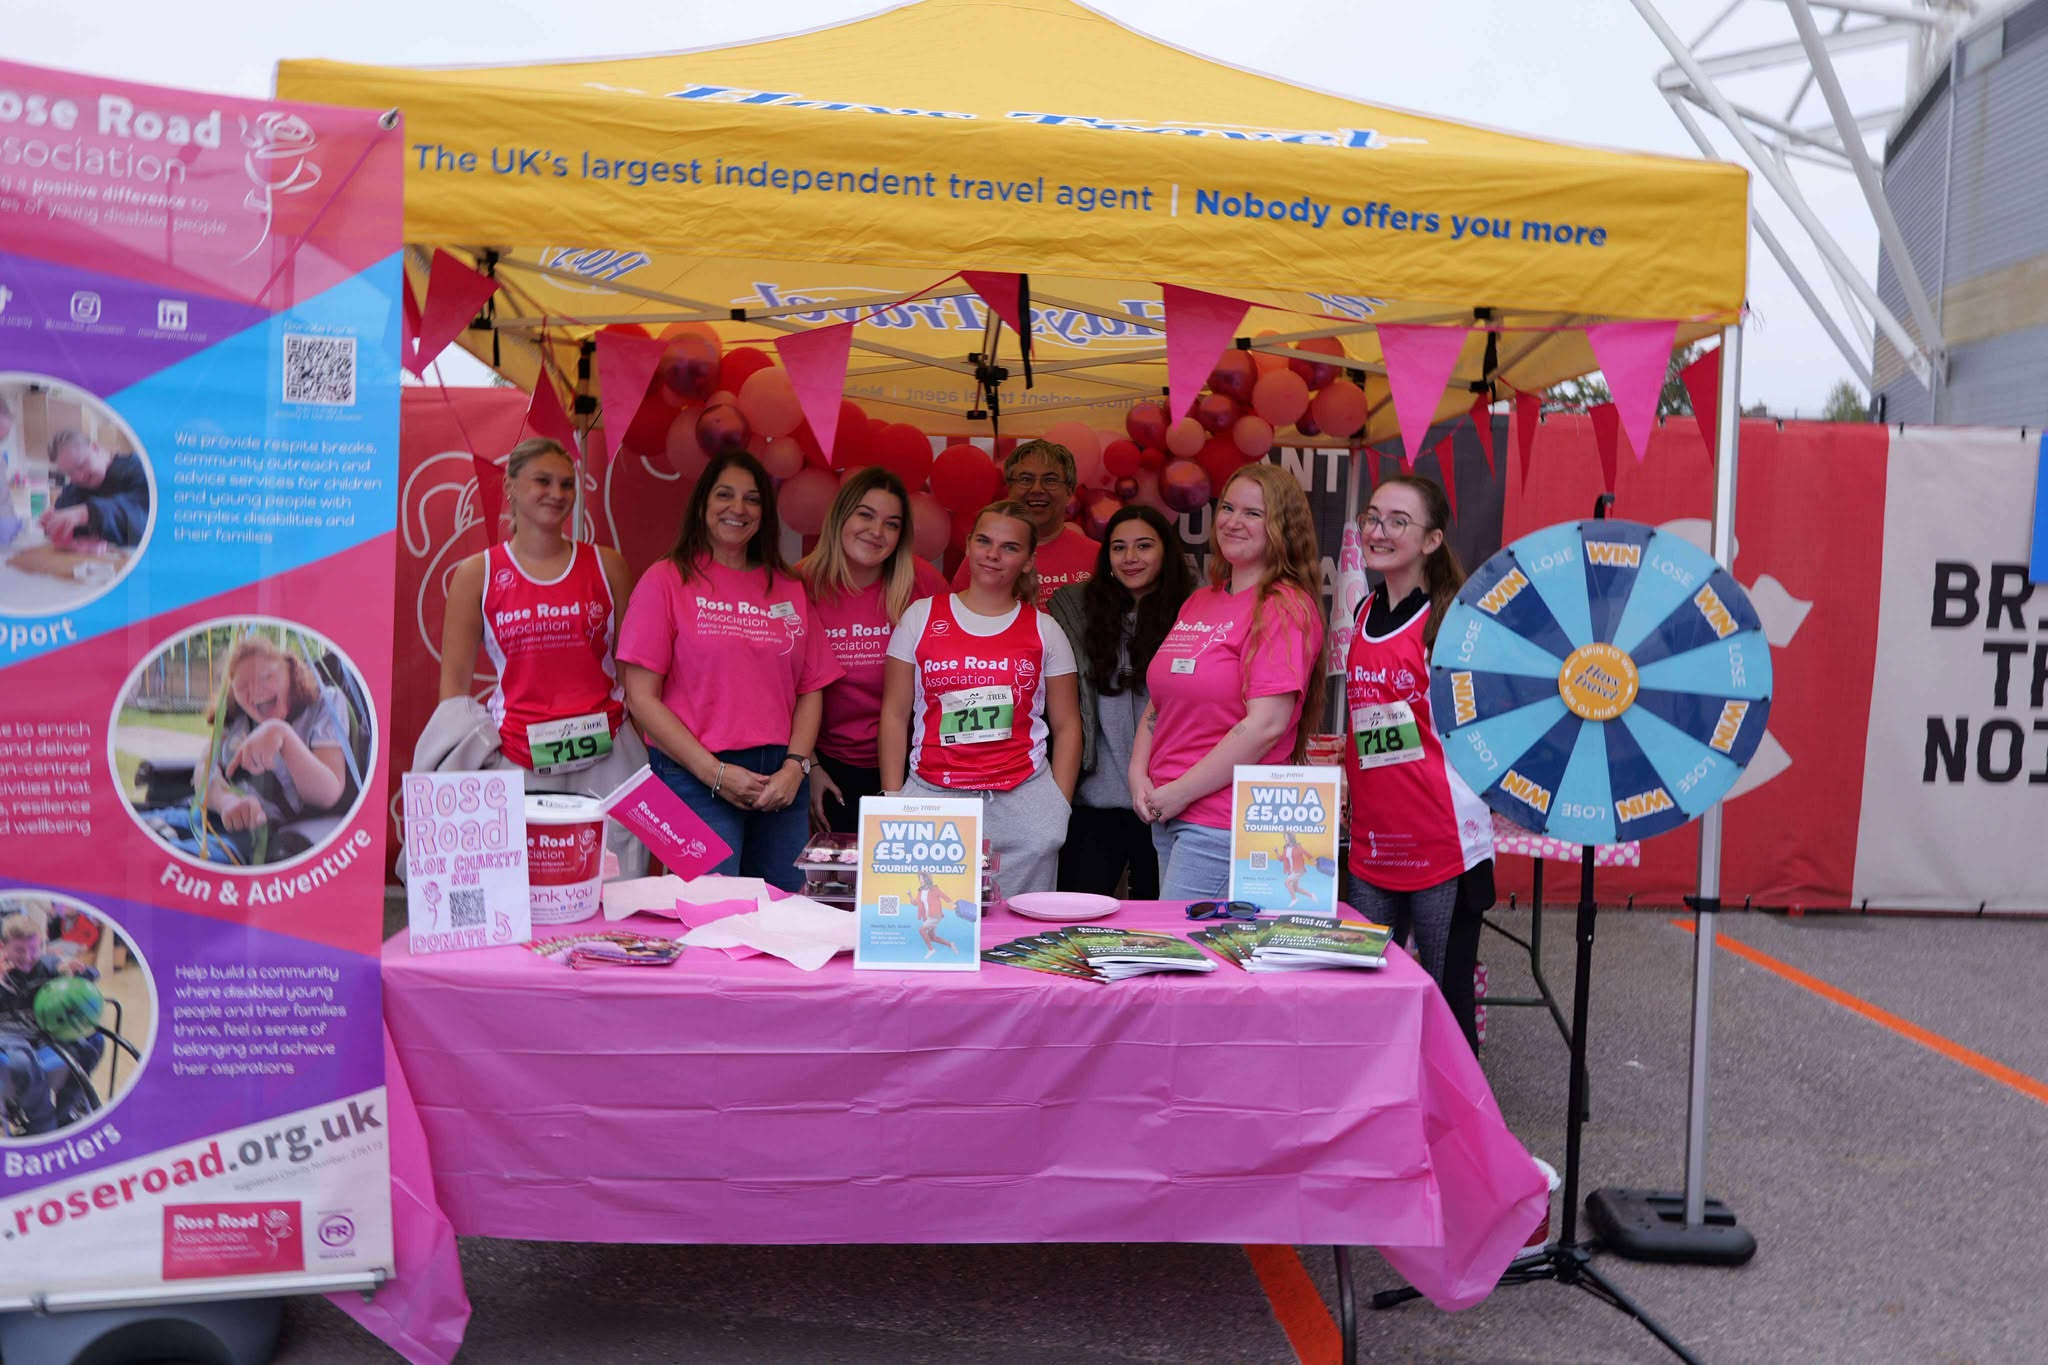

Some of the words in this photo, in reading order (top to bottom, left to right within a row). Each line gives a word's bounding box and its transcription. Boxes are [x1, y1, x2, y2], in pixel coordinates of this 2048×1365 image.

[0, 91, 79, 131] ose
[98, 93, 222, 150] Road
[0, 135, 188, 185] sociation
[412, 143, 477, 173] The
[492, 147, 568, 178] UK's
[582, 151, 702, 187] largest
[715, 157, 936, 197] independent
[949, 172, 1044, 204] travel
[1056, 183, 1154, 213] agent
[1195, 188, 1330, 229] Nobody
[1342, 201, 1440, 233] offers
[1451, 212, 1511, 240] you
[1520, 217, 1608, 247] more
[174, 432, 197, 447] We
[201, 434, 260, 450] provide
[265, 438, 318, 453] respite
[174, 453, 264, 471] community
[267, 457, 339, 472] outreach
[342, 459, 371, 472] and
[174, 471, 226, 486] advice
[230, 473, 294, 489] services
[298, 475, 320, 490] for
[324, 476, 382, 490] children
[174, 490, 206, 504] and
[209, 494, 262, 509] young
[266, 493, 316, 509] people
[320, 495, 352, 509] with
[174, 509, 240, 525] complex
[244, 511, 322, 527] disabilities
[326, 512, 355, 527] and
[174, 527, 213, 542] their
[216, 528, 273, 544] families
[1531, 547, 1575, 574] LOSE
[1585, 541, 1641, 568] WIN
[1650, 554, 1695, 588] LOSE
[1477, 567, 1529, 615] WIN
[696, 596, 733, 611] Rose
[1694, 582, 1739, 640] WIN
[496, 607, 531, 627] Rose
[537, 601, 580, 618] Road
[697, 608, 768, 627] Association
[0, 615, 77, 654] port
[500, 619, 570, 641] Association
[825, 628, 847, 638] ose
[852, 622, 890, 637] Road
[831, 639, 880, 650] ociation
[1457, 619, 1482, 663] LOSE
[924, 659, 958, 674] Rose
[964, 656, 1009, 671] Road
[1728, 642, 1746, 689] LOSE
[925, 671, 995, 688] Association
[1355, 666, 1386, 684] Road
[1451, 671, 1477, 726] WIN
[37, 720, 91, 737] enrich
[954, 706, 1000, 732] 717
[1709, 700, 1750, 754] WIN
[35, 739, 91, 757] deliver
[545, 736, 597, 763] 719
[1360, 727, 1403, 754] 718
[1466, 730, 1498, 772] LOSE
[1677, 756, 1717, 794] LOSE
[0, 780, 51, 796] ivities
[54, 778, 91, 796] that
[1252, 788, 1298, 804] WIN
[1302, 789, 1320, 805] A
[1500, 769, 1551, 815] WIN
[13, 797, 91, 816] resilience
[1246, 805, 1325, 824] £5,000
[1560, 802, 1607, 820] LOSE
[1615, 788, 1675, 823] WIN
[13, 816, 91, 837] wellbeing
[638, 800, 660, 824] Rose
[660, 821, 686, 845] Road
[881, 823, 934, 841] WIN
[940, 823, 959, 841] A
[1245, 824, 1284, 832] TOURING
[1286, 825, 1326, 833] HOLIDAY
[539, 832, 575, 848] Road
[453, 850, 522, 873] CHARITY
[528, 848, 565, 859] ciation
[875, 842, 964, 863] £5,000
[160, 862, 212, 902] Fun
[218, 880, 239, 906] &
[247, 828, 372, 906] Adventure
[873, 864, 919, 873] TOURING
[921, 864, 966, 874] HOLIDAY
[451, 872, 480, 886] RUN
[530, 889, 561, 904] ank
[565, 886, 593, 900] You
[412, 928, 487, 951] DONATE
[175, 964, 208, 982] Help
[210, 964, 245, 980] build
[248, 968, 257, 980] a
[259, 965, 339, 982] community
[175, 984, 221, 999] where
[223, 984, 283, 999] disabled
[286, 985, 334, 1001] young
[173, 1002, 222, 1020] people
[224, 1003, 254, 1017] and
[256, 1003, 291, 1017] their
[293, 1003, 347, 1018] families
[224, 1022, 250, 1037] feel
[252, 1024, 262, 1036] a
[264, 1023, 309, 1037] sense
[310, 1021, 328, 1037] of
[173, 1041, 247, 1059] belonging
[249, 1041, 278, 1055] and
[280, 1041, 336, 1055] achieve
[173, 1061, 209, 1076] their
[211, 1062, 295, 1078] aspirations
[4, 1123, 122, 1179] Barriers
[3, 1101, 383, 1241] .roseroad.org.uk
[172, 1213, 215, 1230] Rose
[217, 1212, 259, 1228] Road
